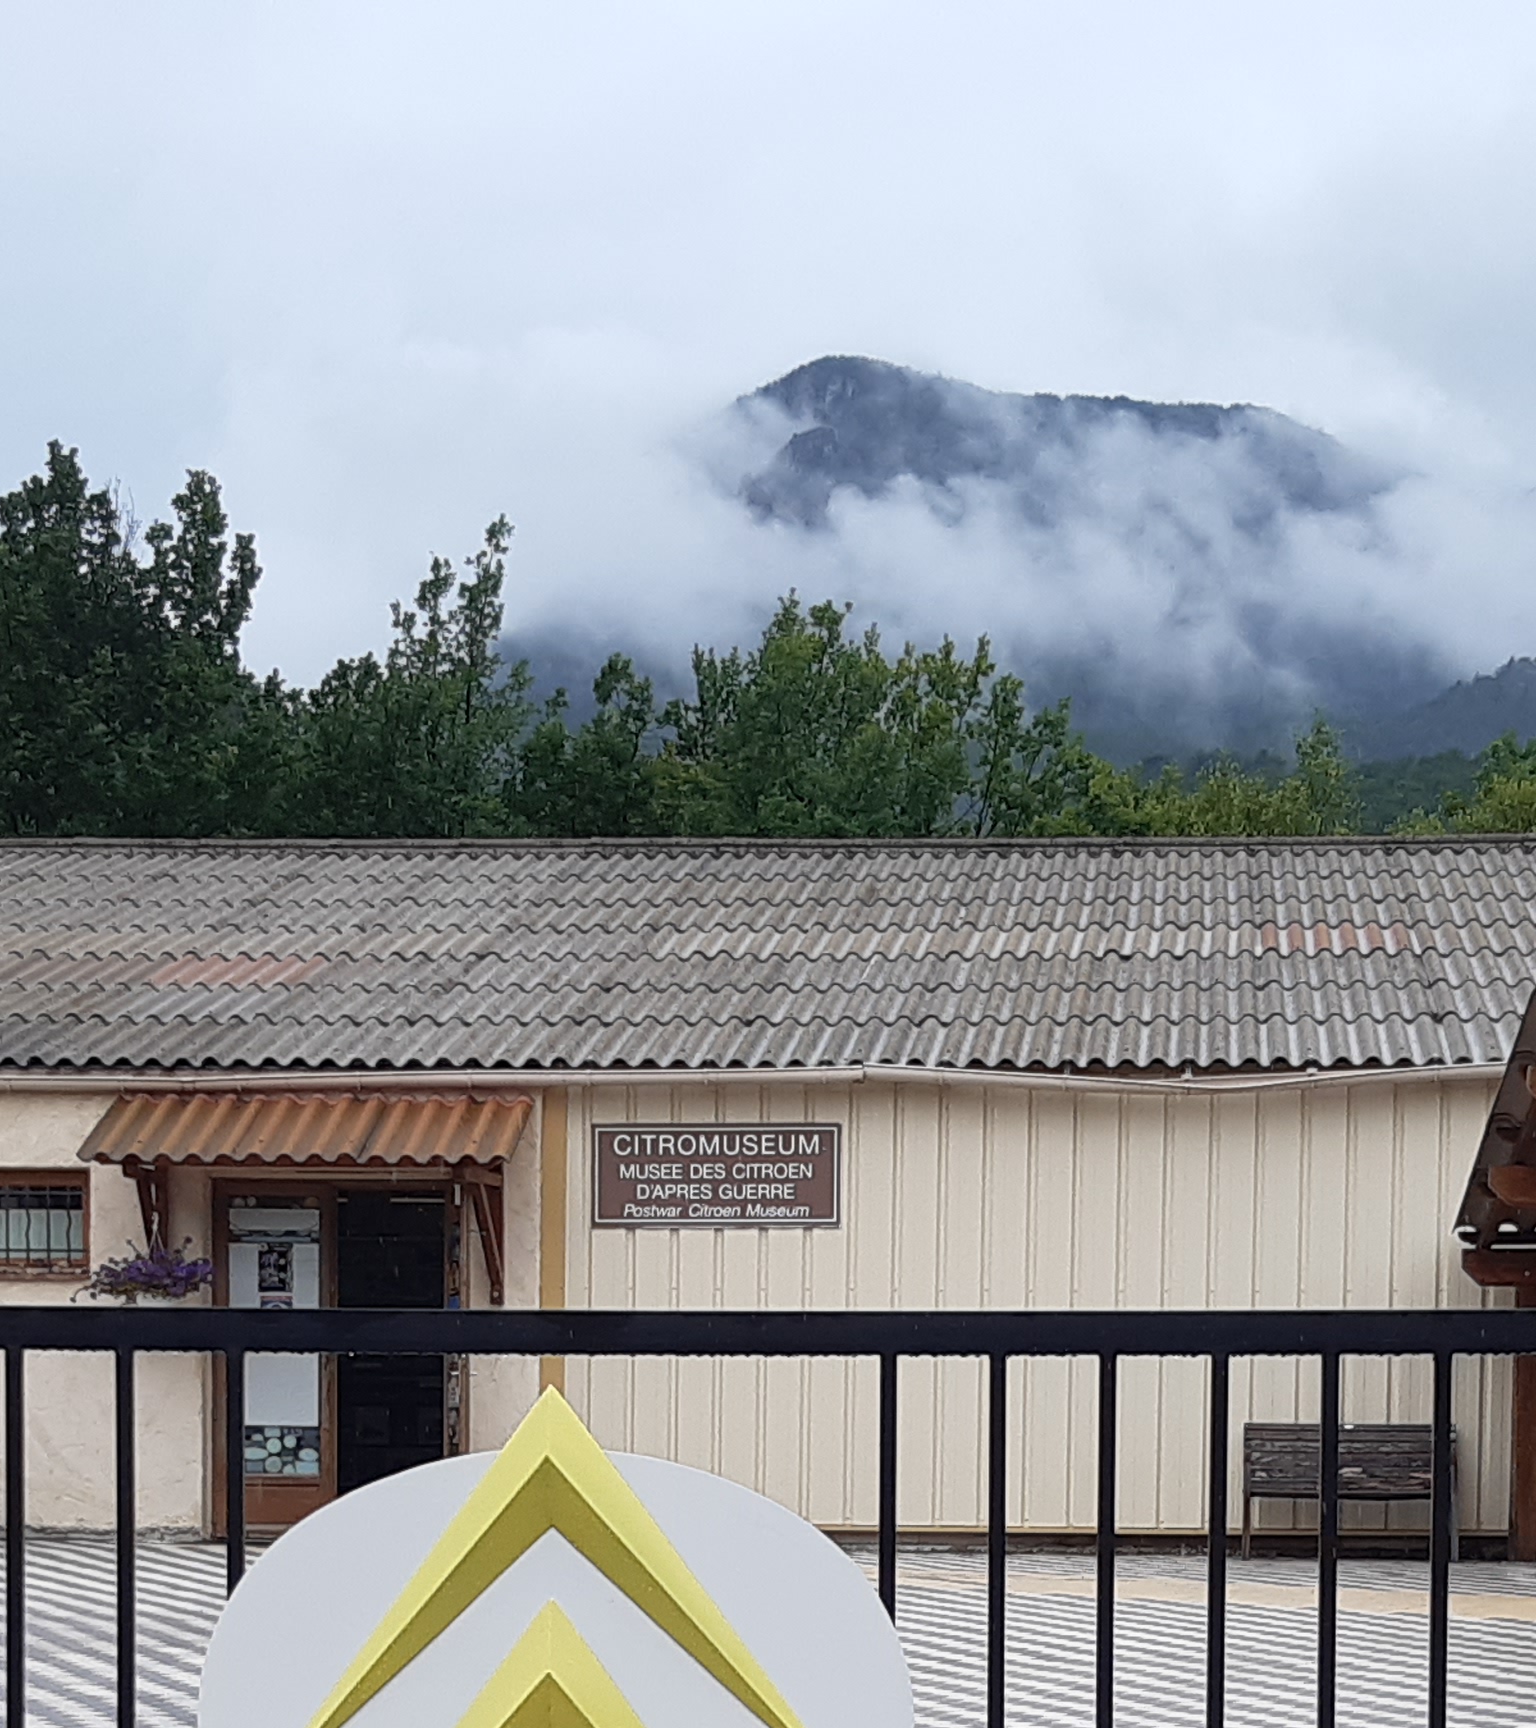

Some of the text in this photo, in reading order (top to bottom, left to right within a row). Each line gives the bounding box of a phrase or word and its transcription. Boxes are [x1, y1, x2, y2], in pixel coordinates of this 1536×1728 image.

[613, 1134, 820, 1156] CITROMUSEUM
[619, 1163, 813, 1180] MUSEE DES CITROEN
[636, 1183, 796, 1200] D'APRES GUERRE
[623, 1203, 810, 1218] Postwar Citroen Museum
